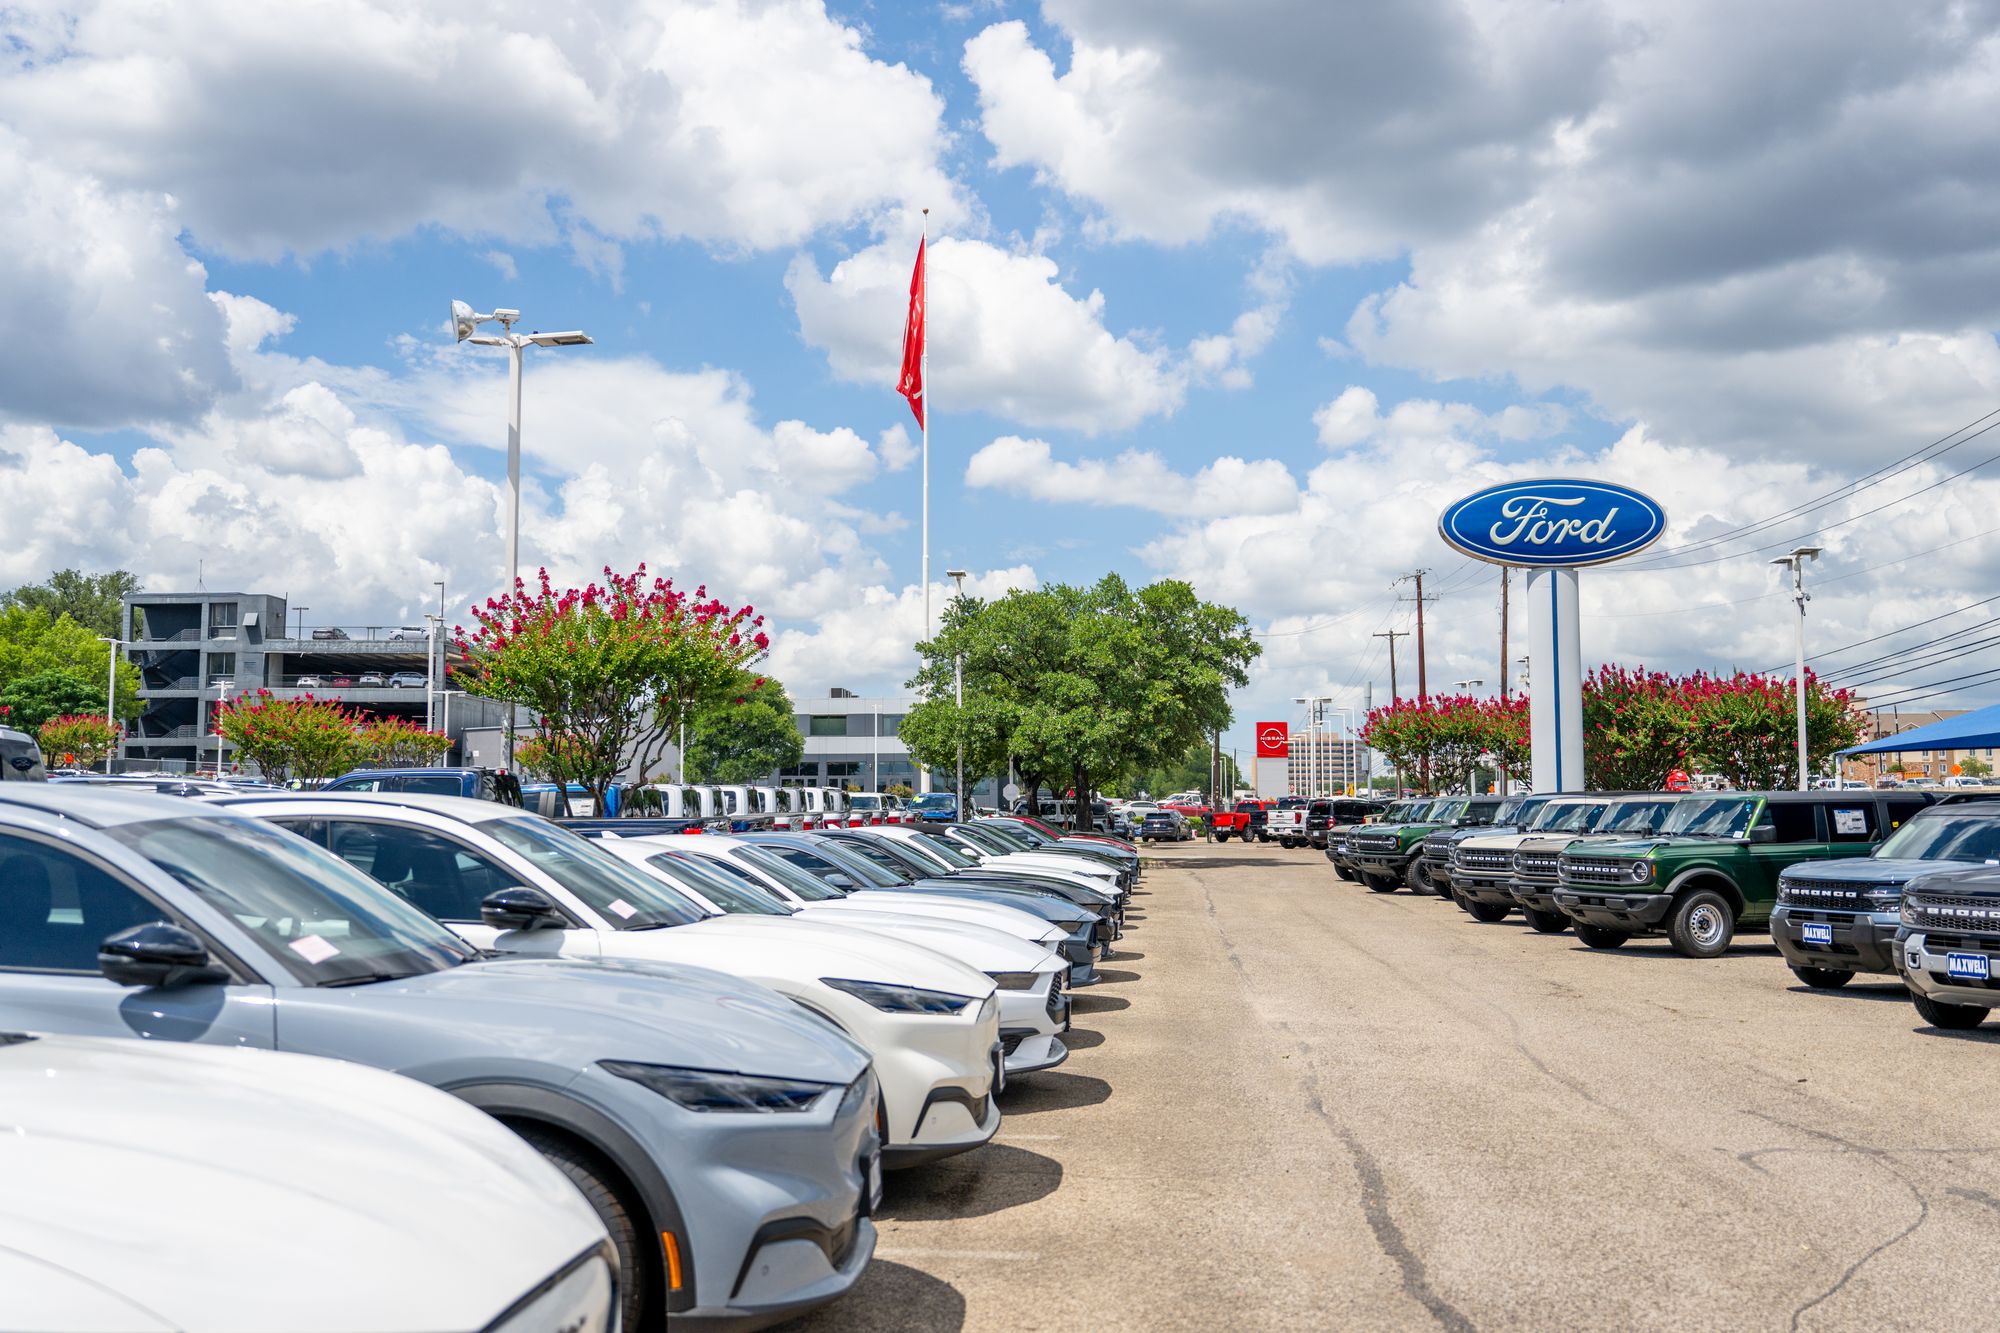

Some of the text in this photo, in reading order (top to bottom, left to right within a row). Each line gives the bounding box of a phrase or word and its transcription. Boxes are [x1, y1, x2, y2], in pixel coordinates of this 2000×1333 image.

[1489, 495, 1619, 544] Ford
[1571, 865, 1618, 873] BRONCO
[1791, 888, 1857, 898] BRONCO
[1927, 907, 2000, 919] BRONC
[1804, 926, 1830, 940] MAXWELL
[1949, 957, 1986, 974] MAXWELL
